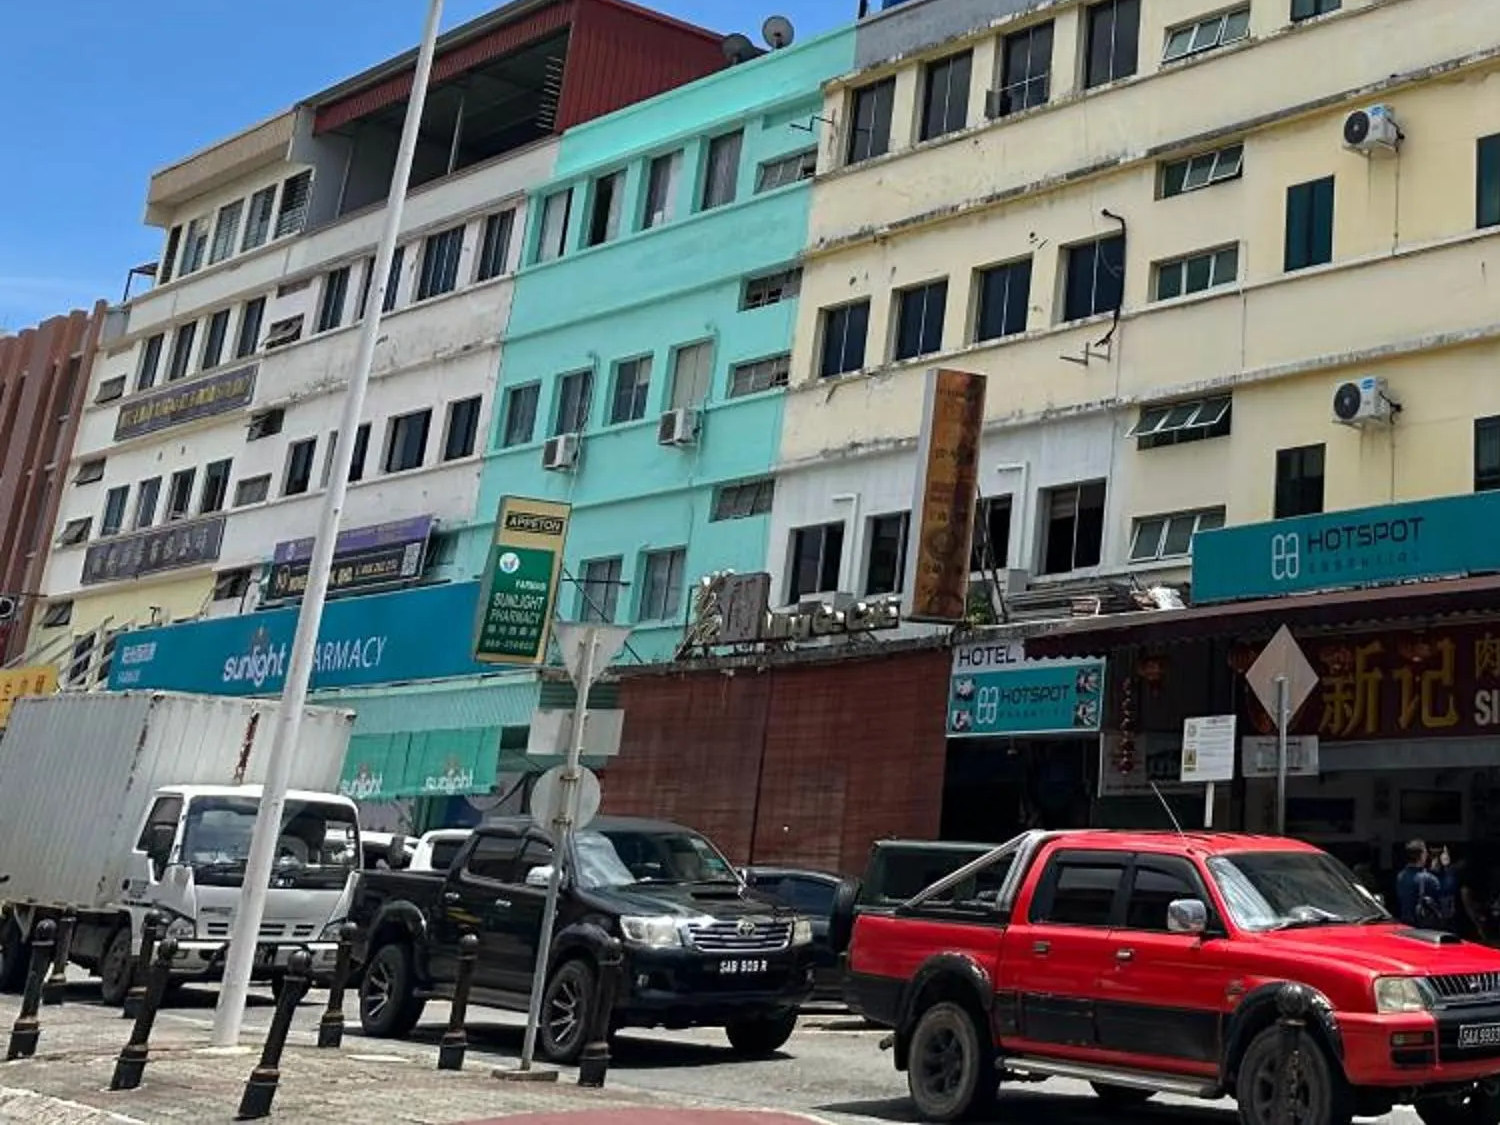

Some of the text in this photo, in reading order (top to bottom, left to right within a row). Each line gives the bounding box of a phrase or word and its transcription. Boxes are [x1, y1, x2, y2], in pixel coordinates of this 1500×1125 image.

[509, 516, 562, 532] APPETON
[1307, 517, 1424, 553] HOTSPOT
[493, 592, 545, 611] SUNLIGHT
[489, 608, 541, 625] PHARMACY
[222, 636, 387, 687] sunlight ARMACY
[958, 644, 1017, 667] HOTEL
[1001, 685, 1070, 705] HOTSPOT
